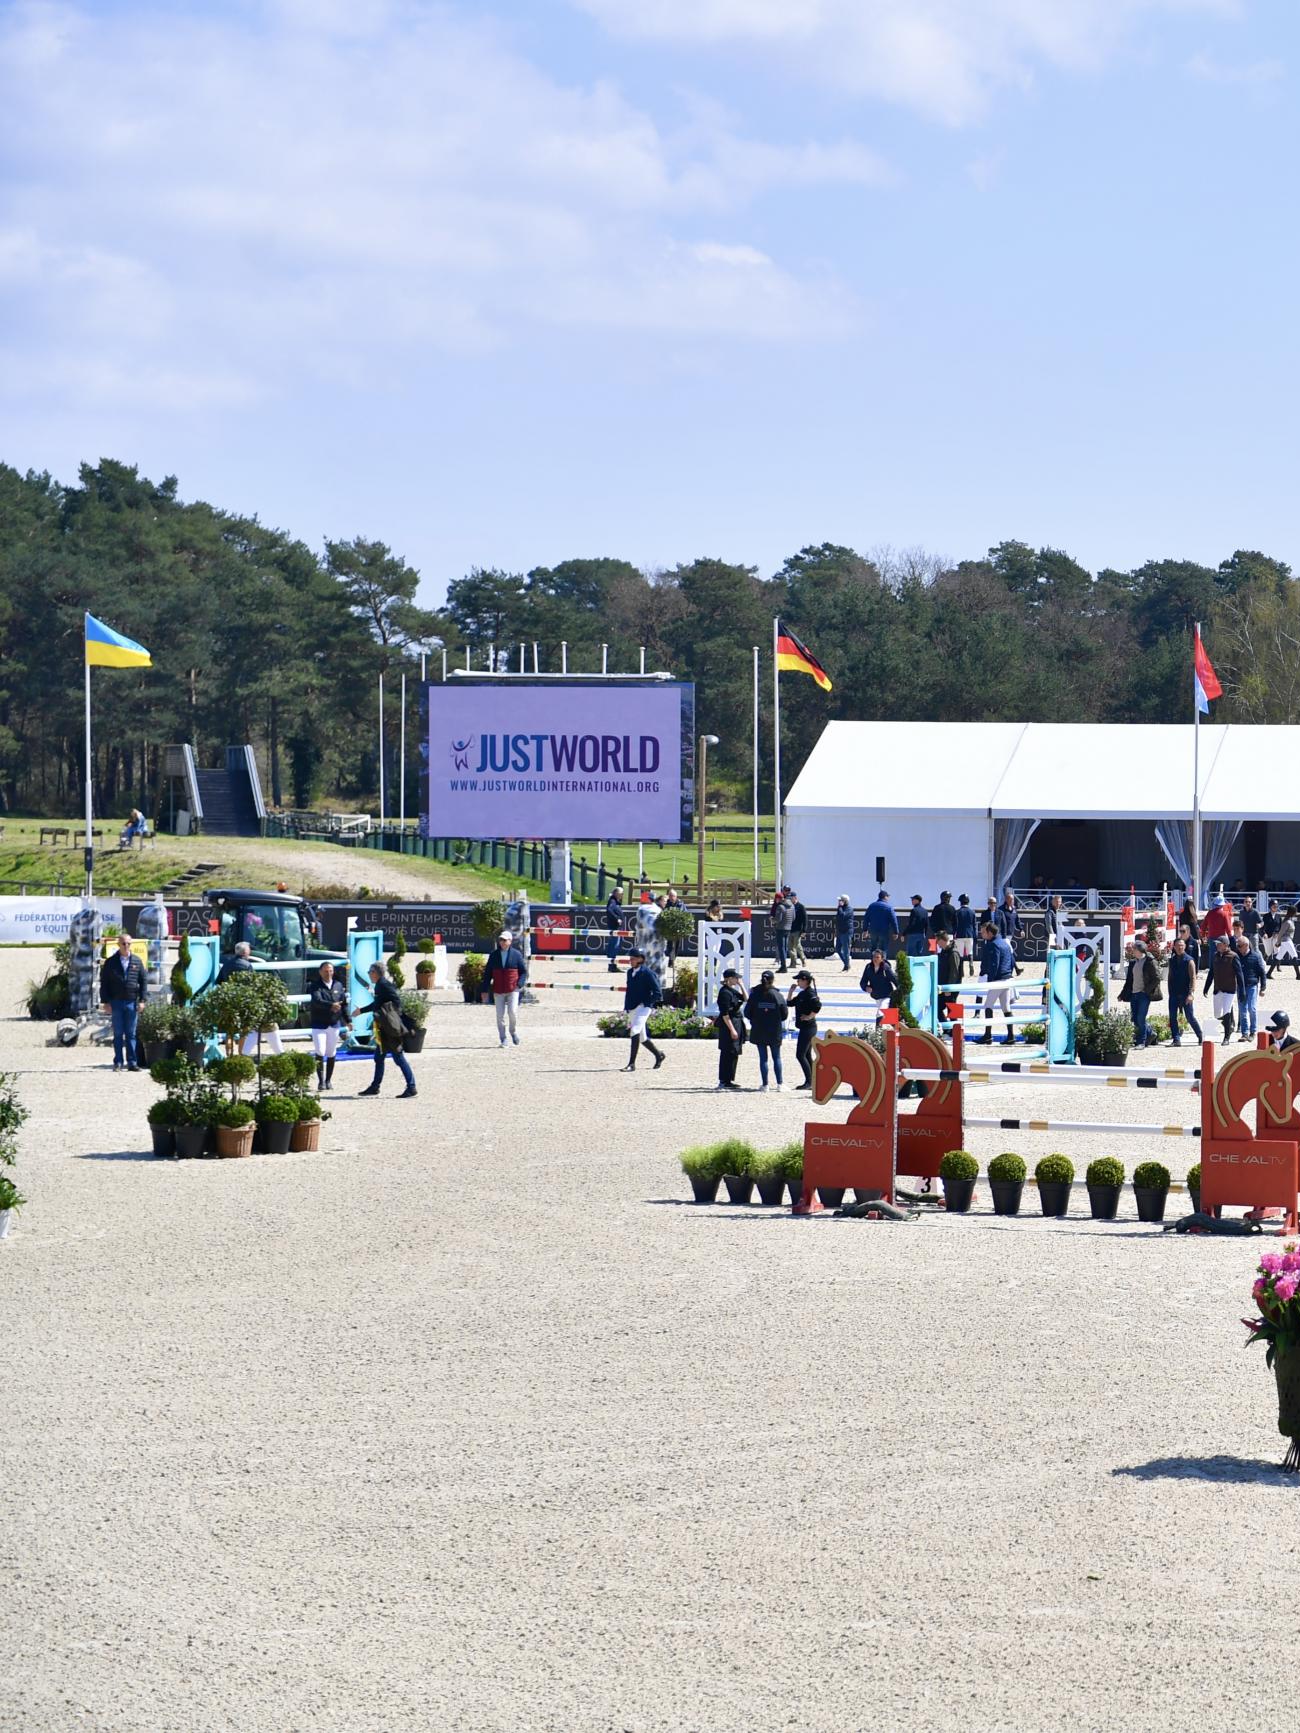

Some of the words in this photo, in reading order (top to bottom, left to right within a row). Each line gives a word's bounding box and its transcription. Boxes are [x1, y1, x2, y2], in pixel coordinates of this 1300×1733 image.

[476, 734, 660, 773] JUSTWORLD
[450, 780, 660, 793] WWW.JUSTWORLDINTERNATIONAL.ORG
[14, 913, 68, 922] FÉDÉRATION
[365, 914, 378, 922] LE
[382, 914, 448, 924] PRINTEMPS
[921, 1177, 931, 1193] 3
